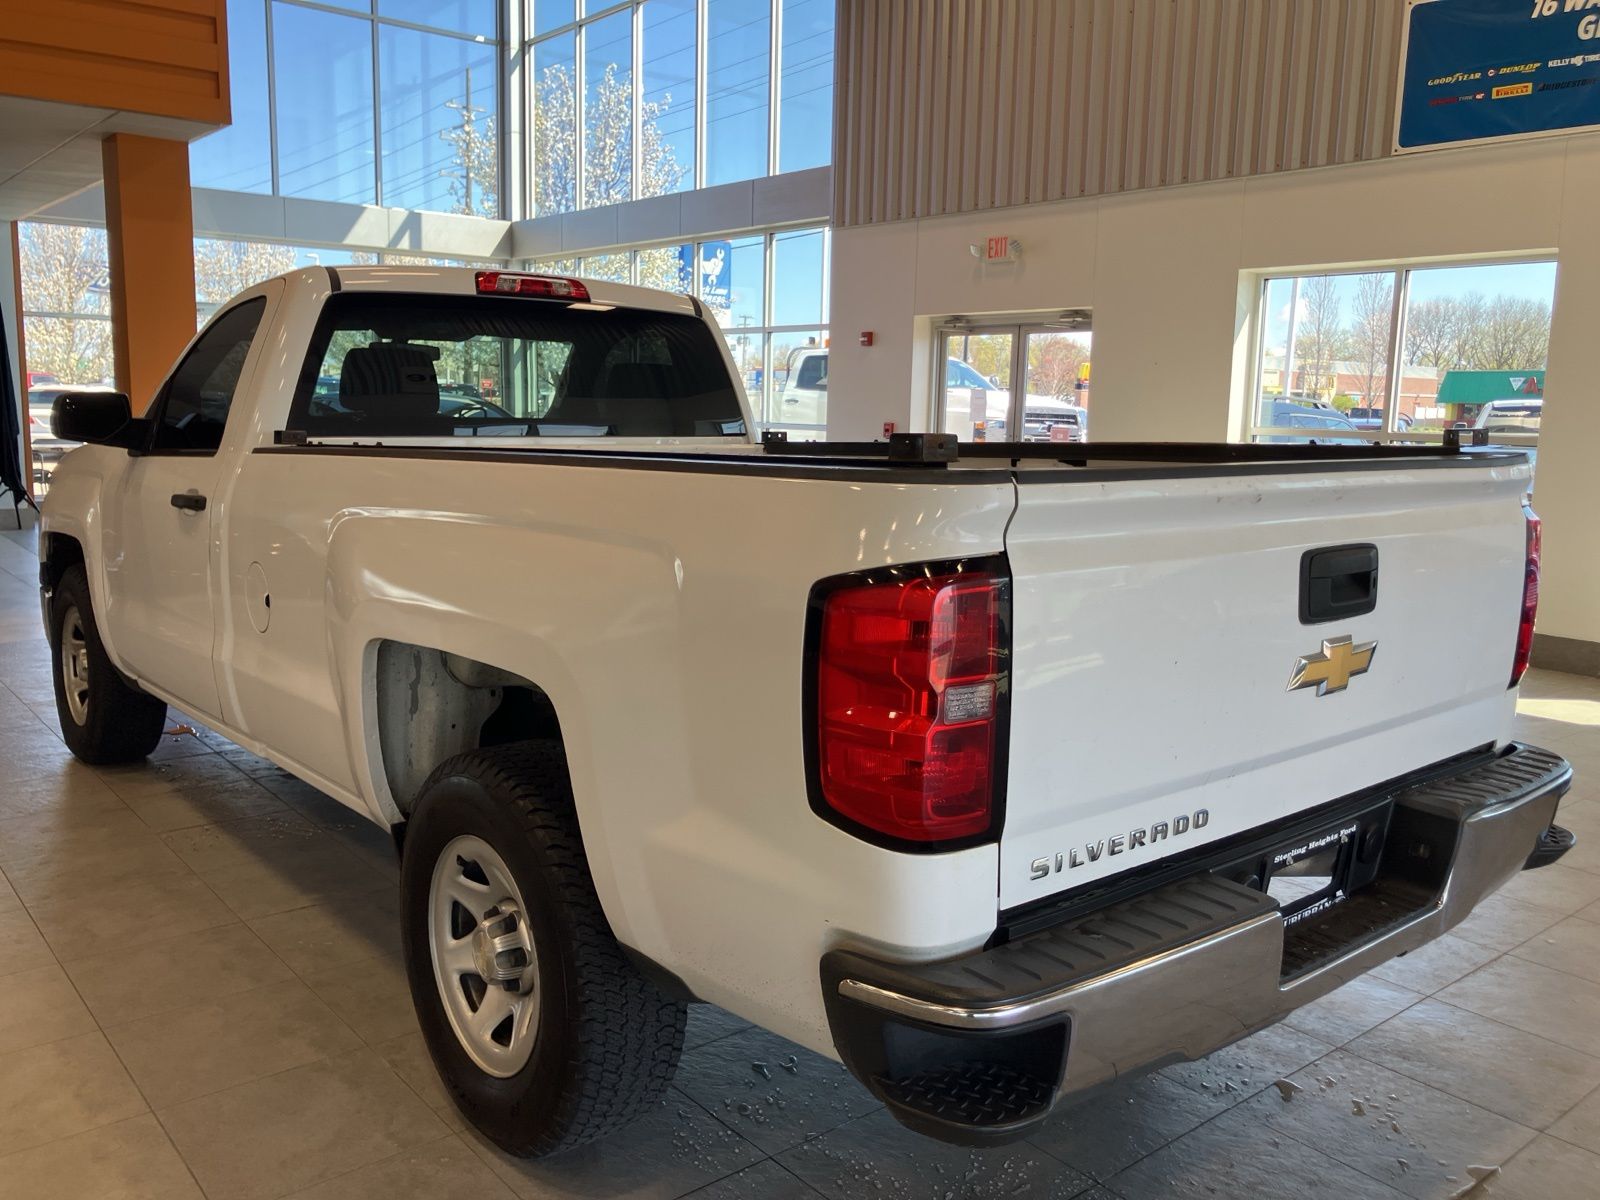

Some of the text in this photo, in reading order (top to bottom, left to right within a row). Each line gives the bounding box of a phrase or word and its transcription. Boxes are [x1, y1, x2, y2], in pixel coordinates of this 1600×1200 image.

[1531, 0, 1558, 18] 16
[1500, 63, 1542, 74] DUNLOP
[1548, 58, 1570, 67] KELLY
[1427, 72, 1482, 86] GOODYEAR
[1495, 85, 1530, 97] PIRELLI
[988, 236, 1009, 259] EXIT
[1030, 808, 1209, 881] SILVERADO
[1274, 825, 1357, 863] Sterling Heights Ford
